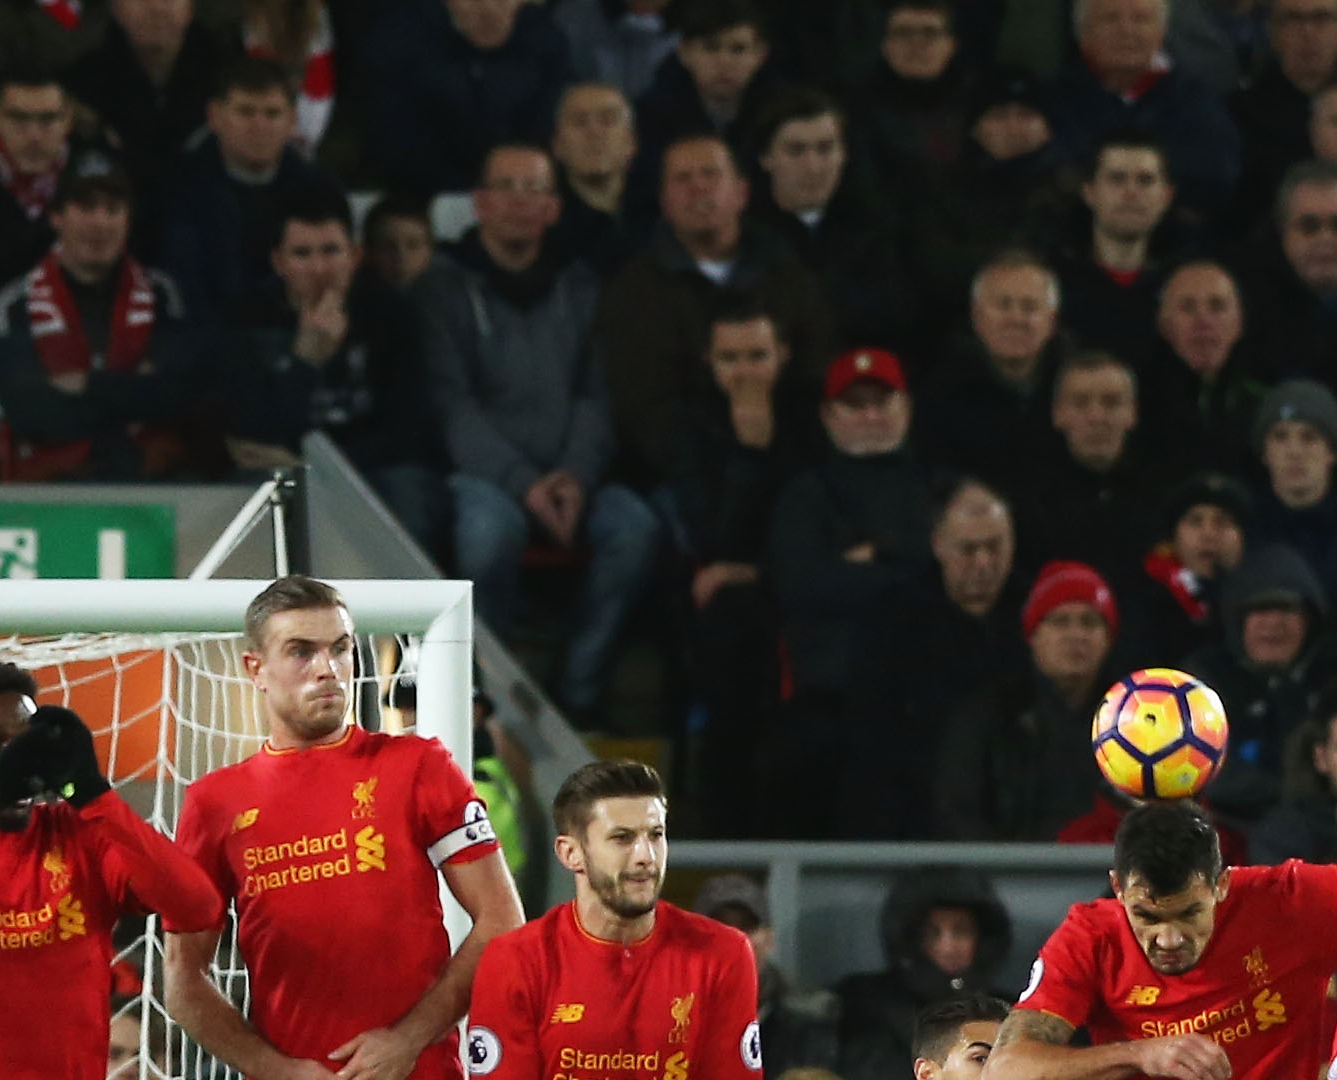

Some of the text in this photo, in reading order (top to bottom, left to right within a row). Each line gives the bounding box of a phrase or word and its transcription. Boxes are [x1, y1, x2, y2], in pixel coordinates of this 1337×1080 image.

[243, 828, 347, 870] Standard
[244, 855, 351, 897] Chartered
[1141, 1000, 1245, 1038] Standard
[560, 1047, 659, 1071] Standard
